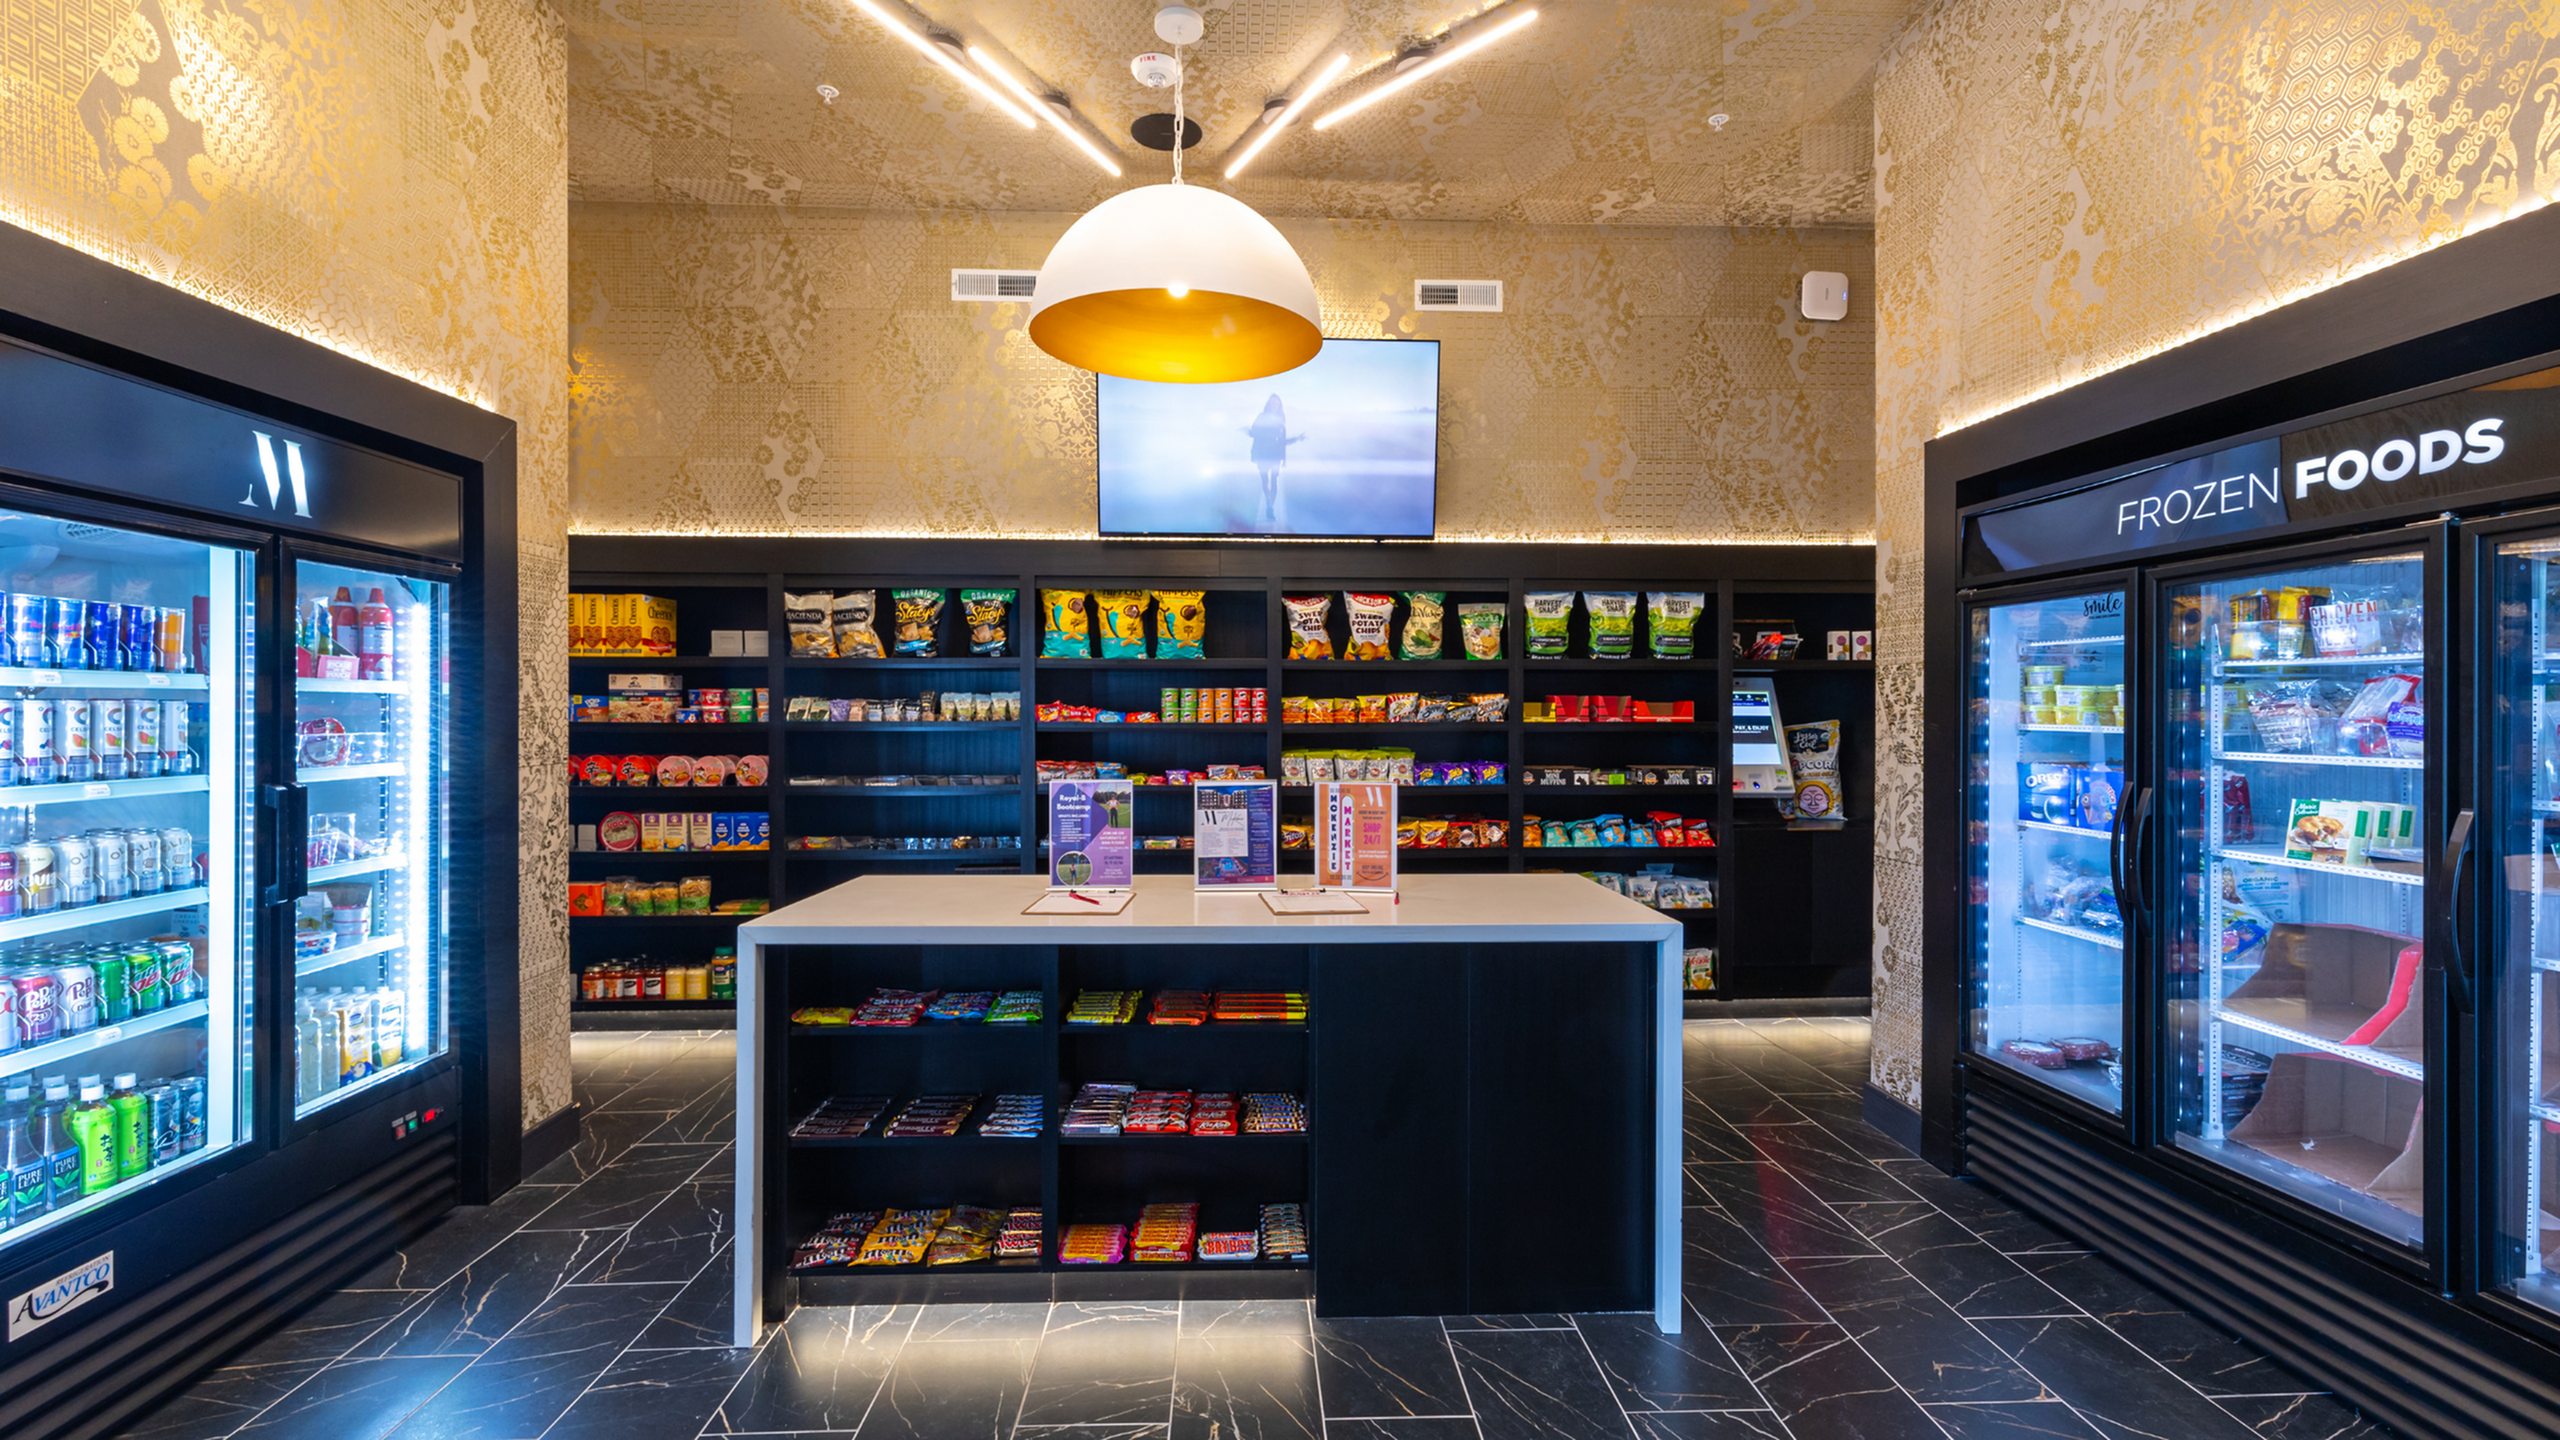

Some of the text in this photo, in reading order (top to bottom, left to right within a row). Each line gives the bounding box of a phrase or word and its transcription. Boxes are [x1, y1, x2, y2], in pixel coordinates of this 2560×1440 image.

[1140, 55, 1156, 63] FIRE
[2117, 418, 2505, 535] FROZEN FOODS
[1534, 598, 1563, 608] HARVEST
[1602, 598, 1627, 607] HARVEST
[1664, 598, 1691, 608] HARVEST
[2083, 592, 2123, 617] smile
[647, 605, 673, 621] Cheerios
[1538, 606, 1560, 614] SNAPS
[1606, 606, 1626, 614] SNAPS
[1667, 606, 1688, 615] SNAPS
[2310, 600, 2378, 626] CHICKEN
[2025, 772, 2062, 788] OREO
[1056, 803, 1091, 812] Bootcamp
[1330, 795, 1338, 870] MCKENZIE
[1363, 822, 1381, 833] SHOP
[1344, 806, 1352, 870] MARKET
[1363, 834, 1381, 845] 24/7
[100, 1133, 115, 1162] お茶
[55, 1155, 78, 1168] PURE
[18, 1167, 43, 1181] PURE
[18, 1177, 42, 1190] LEAF
[1206, 1239, 1251, 1255] PAYDAY
[55, 1255, 110, 1287] REFRIGERATION
[13, 1262, 110, 1326] AVANTCO
